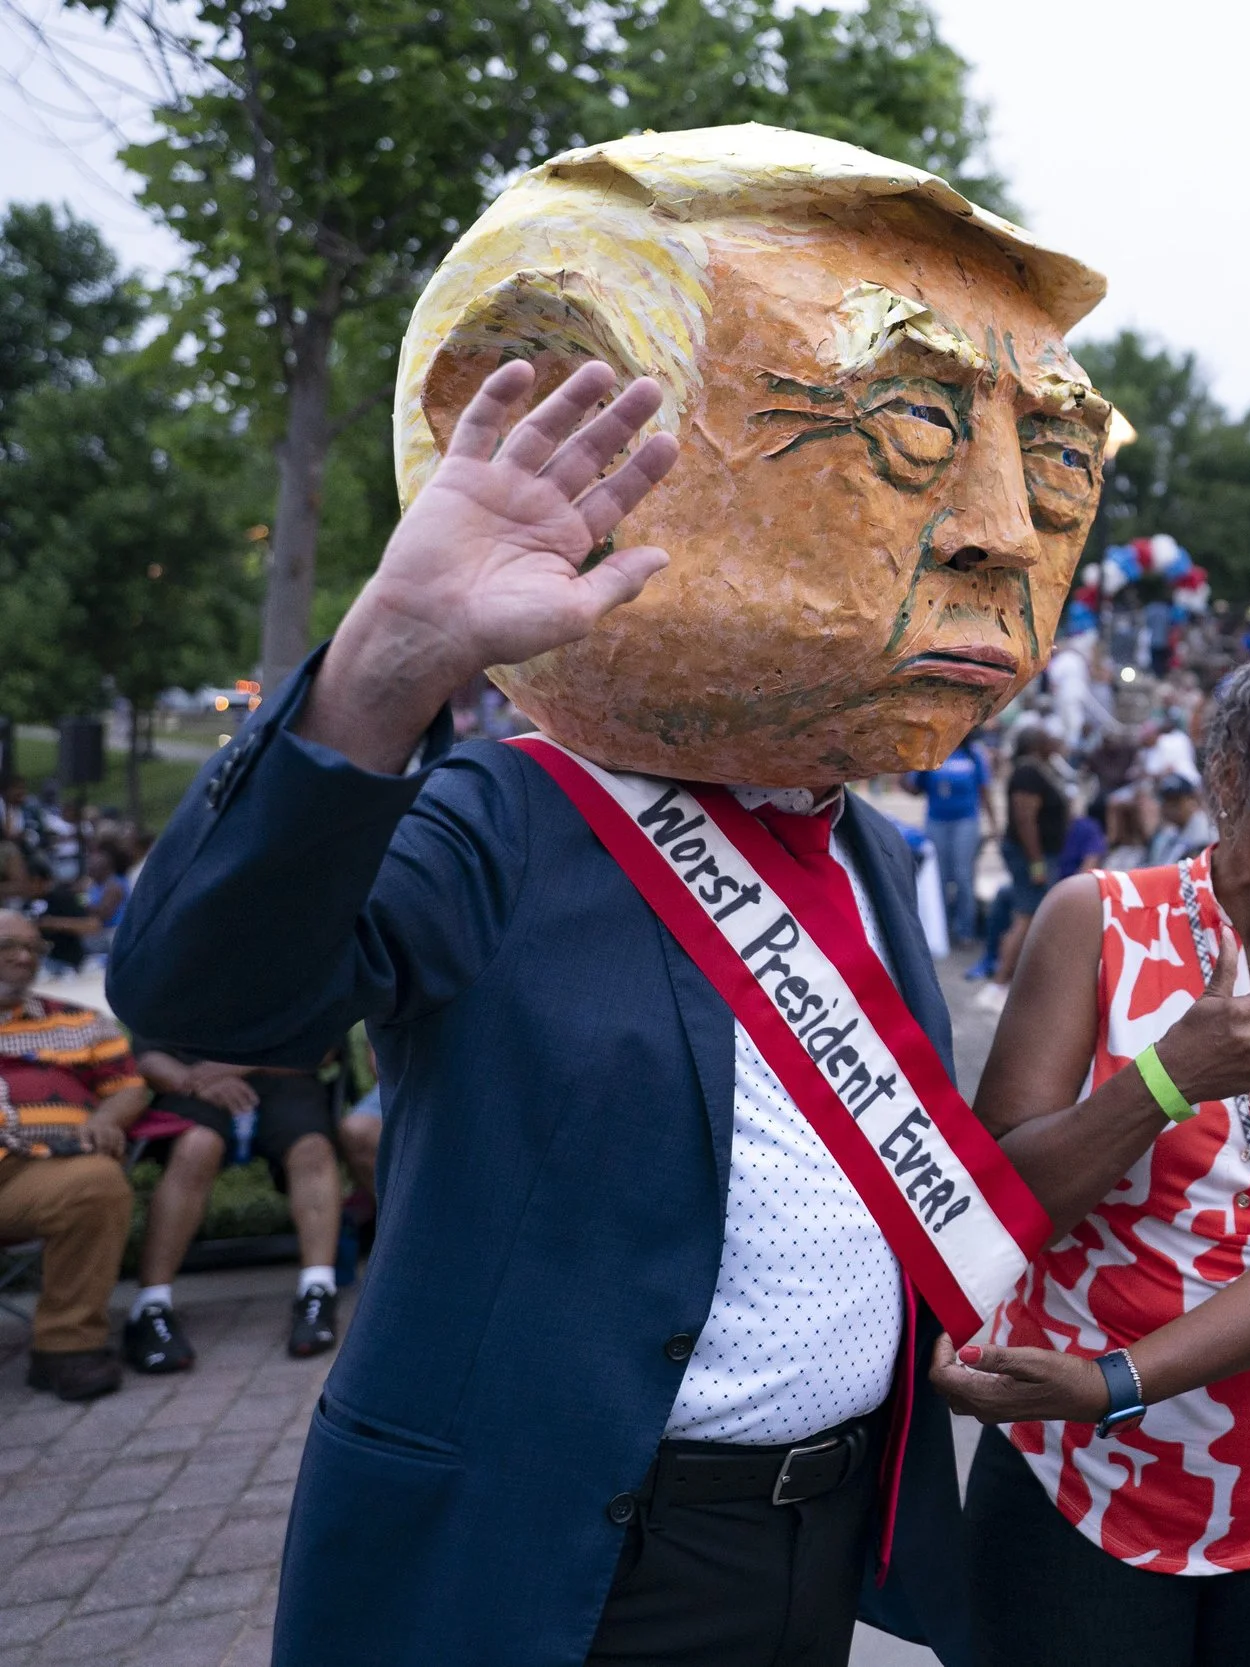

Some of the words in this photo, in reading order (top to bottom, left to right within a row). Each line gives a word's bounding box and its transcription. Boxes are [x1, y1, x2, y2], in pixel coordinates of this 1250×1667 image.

[637, 789, 761, 923] Worst
[741, 912, 897, 1119] President
[880, 1107, 971, 1233] EVER!
